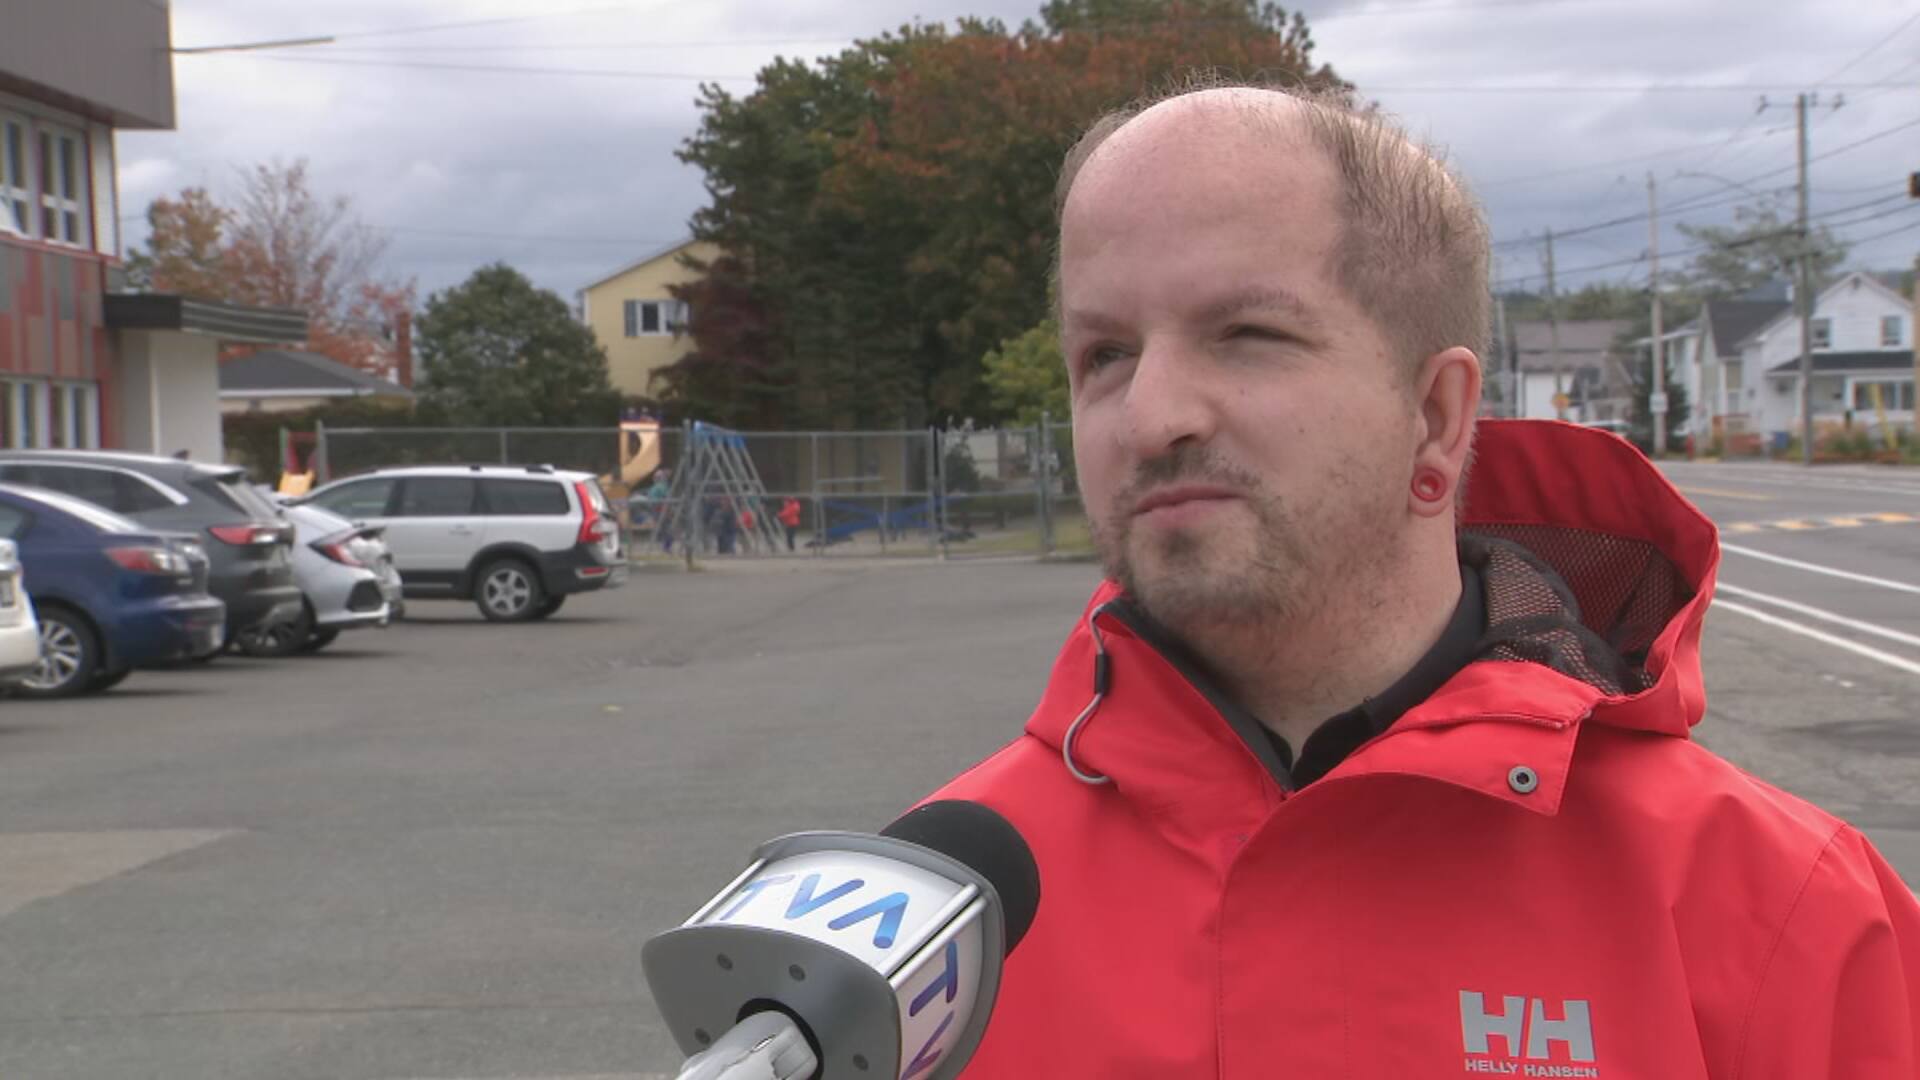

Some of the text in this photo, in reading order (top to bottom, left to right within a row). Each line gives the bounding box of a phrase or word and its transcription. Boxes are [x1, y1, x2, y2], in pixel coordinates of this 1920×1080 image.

[719, 873, 910, 949] TVA
[1459, 990, 1595, 1062] HH
[1465, 1058, 1598, 1078] HELLY HANSEN
